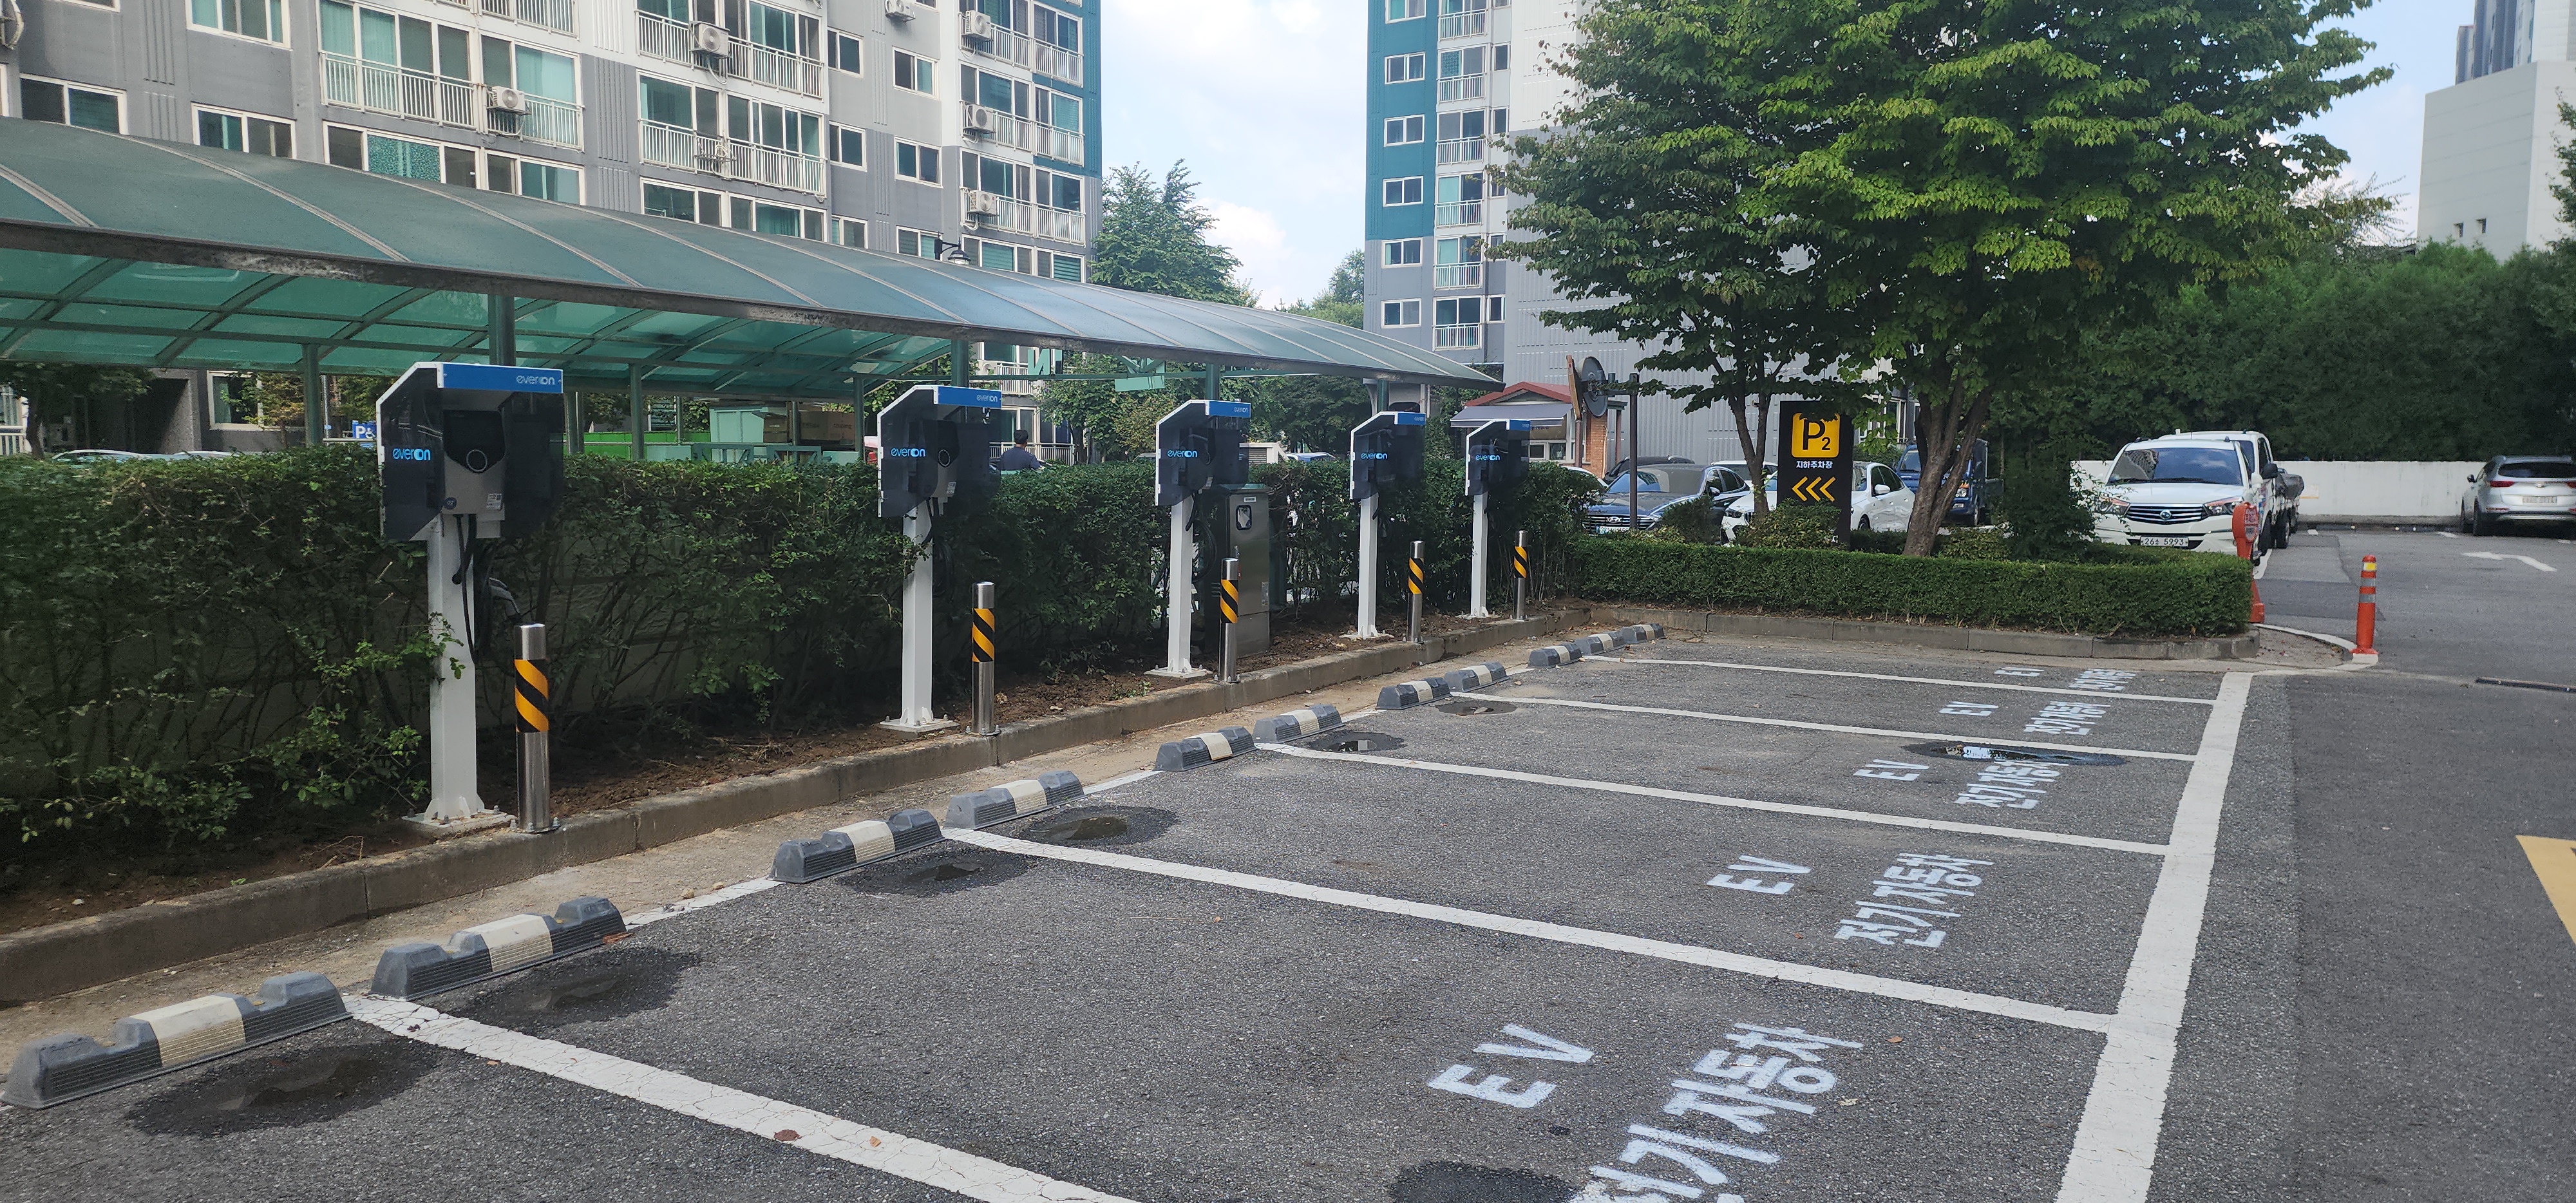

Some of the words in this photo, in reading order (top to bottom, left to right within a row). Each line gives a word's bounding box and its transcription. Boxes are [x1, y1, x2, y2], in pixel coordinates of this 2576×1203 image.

[1795, 460, 1833, 469] 지하주차장
[1938, 701, 1999, 716] EV
[2023, 701, 2112, 735] 전기자동차
[1853, 759, 1930, 782] EV
[1954, 759, 2069, 810] 전기자동차
[1707, 855, 1812, 895] EV
[1834, 853, 1994, 949] 전기자동차
[1427, 1024, 1595, 1109] EV
